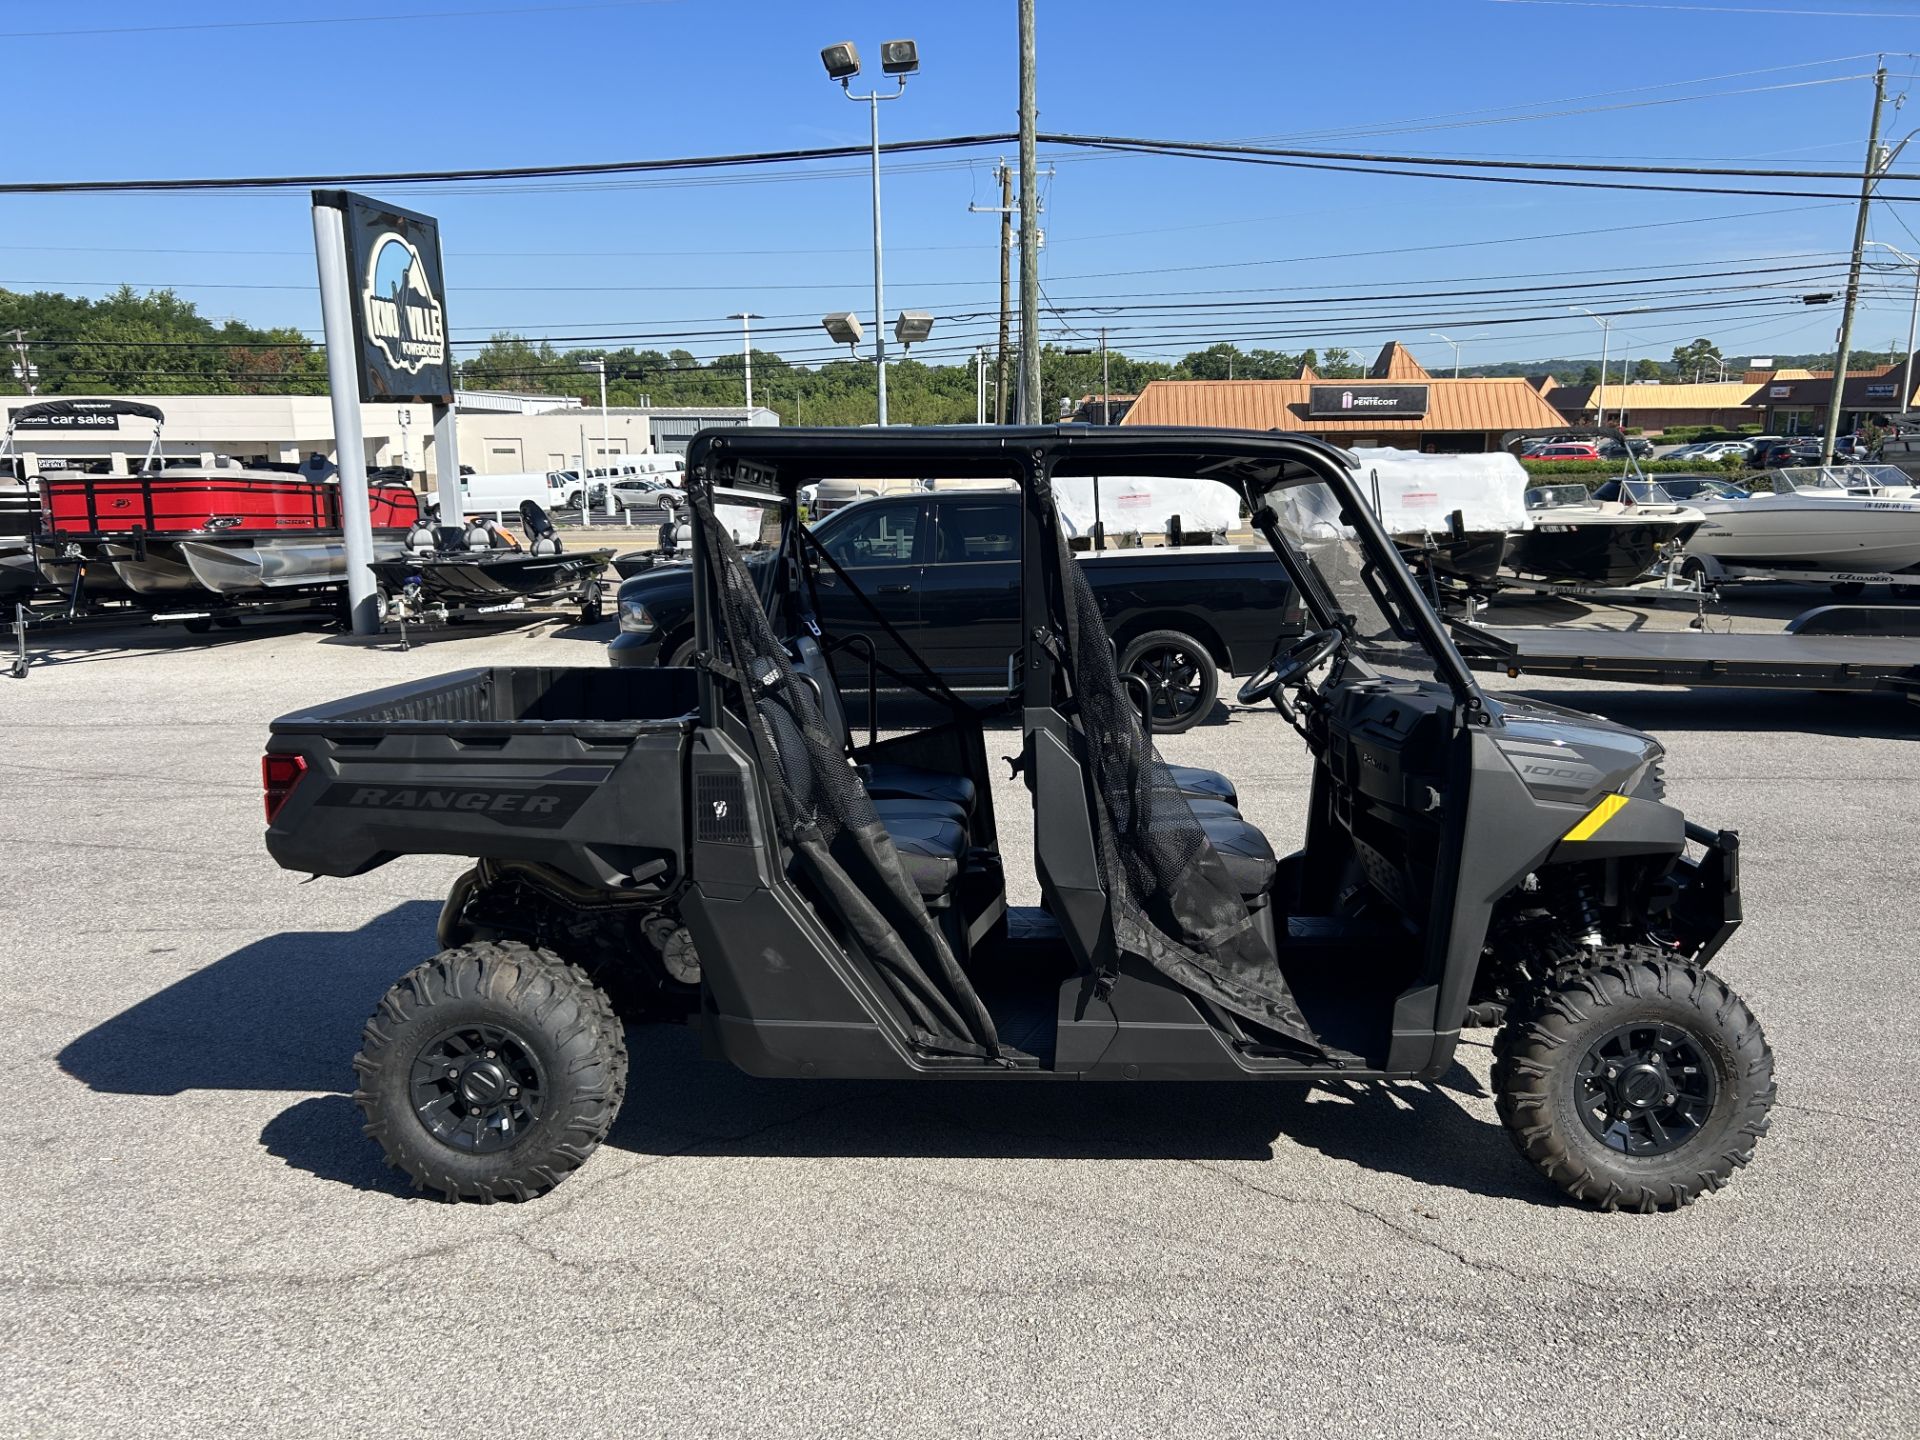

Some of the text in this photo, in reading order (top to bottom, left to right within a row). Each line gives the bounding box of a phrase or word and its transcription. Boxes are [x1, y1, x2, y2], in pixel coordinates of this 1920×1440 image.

[401, 341, 441, 359] POWERSPORTS
[51, 415, 73, 424] car
[77, 414, 115, 424] sales
[1524, 764, 1597, 782] 1000
[350, 788, 561, 813] RANGER
